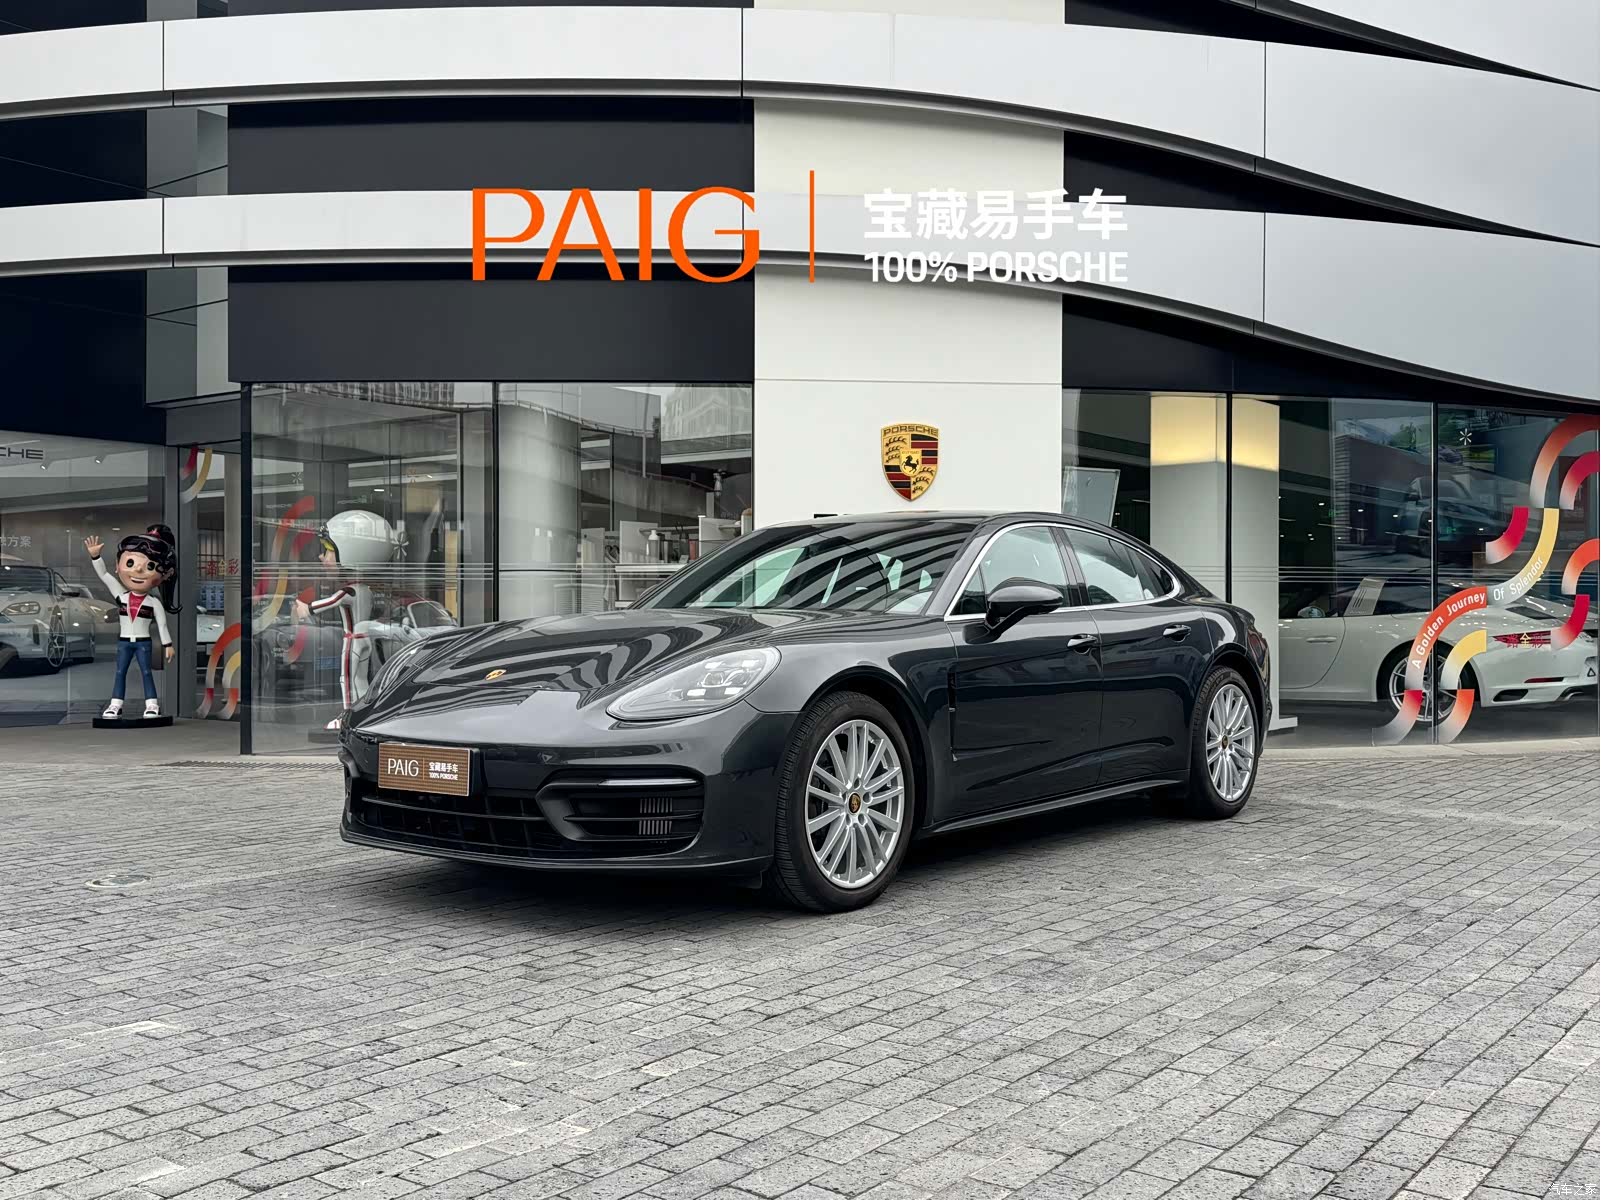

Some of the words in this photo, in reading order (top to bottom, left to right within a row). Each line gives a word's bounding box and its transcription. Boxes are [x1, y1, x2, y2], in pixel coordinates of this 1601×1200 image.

[883, 425, 938, 437] PORSCHE
[1411, 659, 1421, 669] A
[1416, 615, 1444, 656] Golden
[1446, 592, 1486, 616] Journey
[1493, 588, 1505, 601] Of
[1509, 556, 1544, 595] Splendor
[387, 758, 419, 777] PAIG
